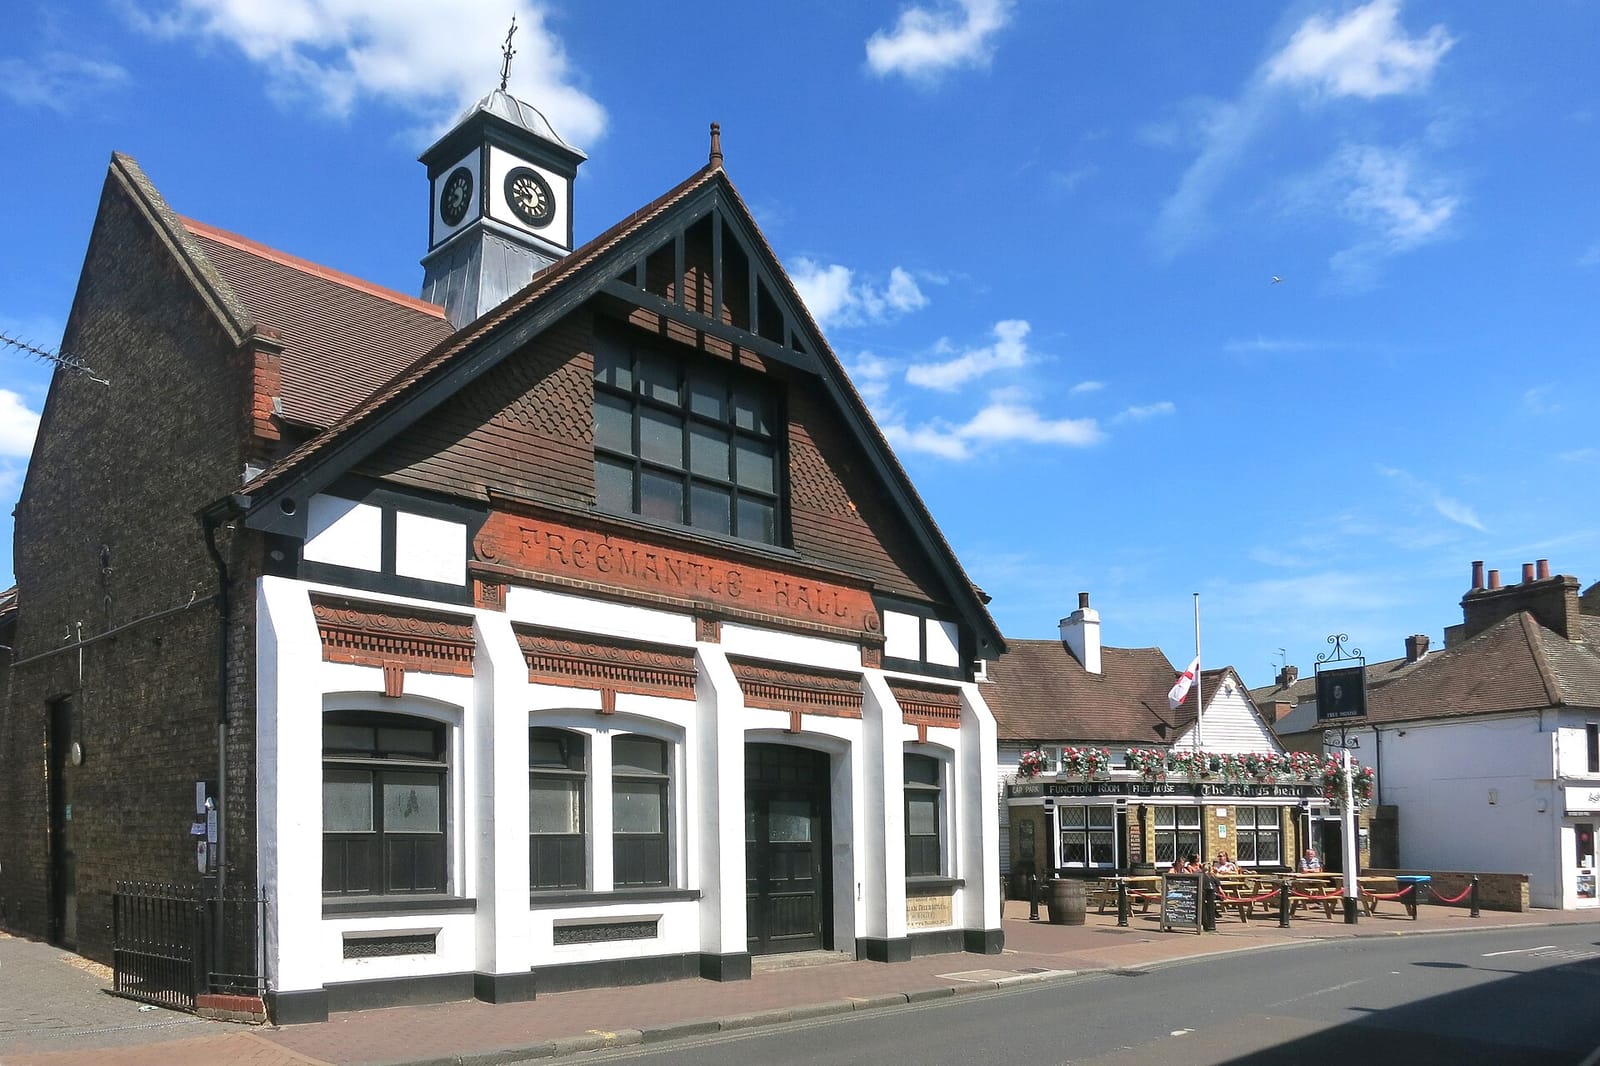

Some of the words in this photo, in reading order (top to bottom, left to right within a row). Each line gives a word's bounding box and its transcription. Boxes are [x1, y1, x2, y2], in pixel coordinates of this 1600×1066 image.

[518, 526, 743, 598] FREEMANTLE
[1012, 785, 1023, 793] CAR
[1025, 785, 1040, 793] PARK
[1049, 784, 1092, 794] FUNCTION
[1098, 784, 1120, 793] ROOM
[1132, 784, 1151, 793] FREE
[1201, 783, 1226, 797] The
